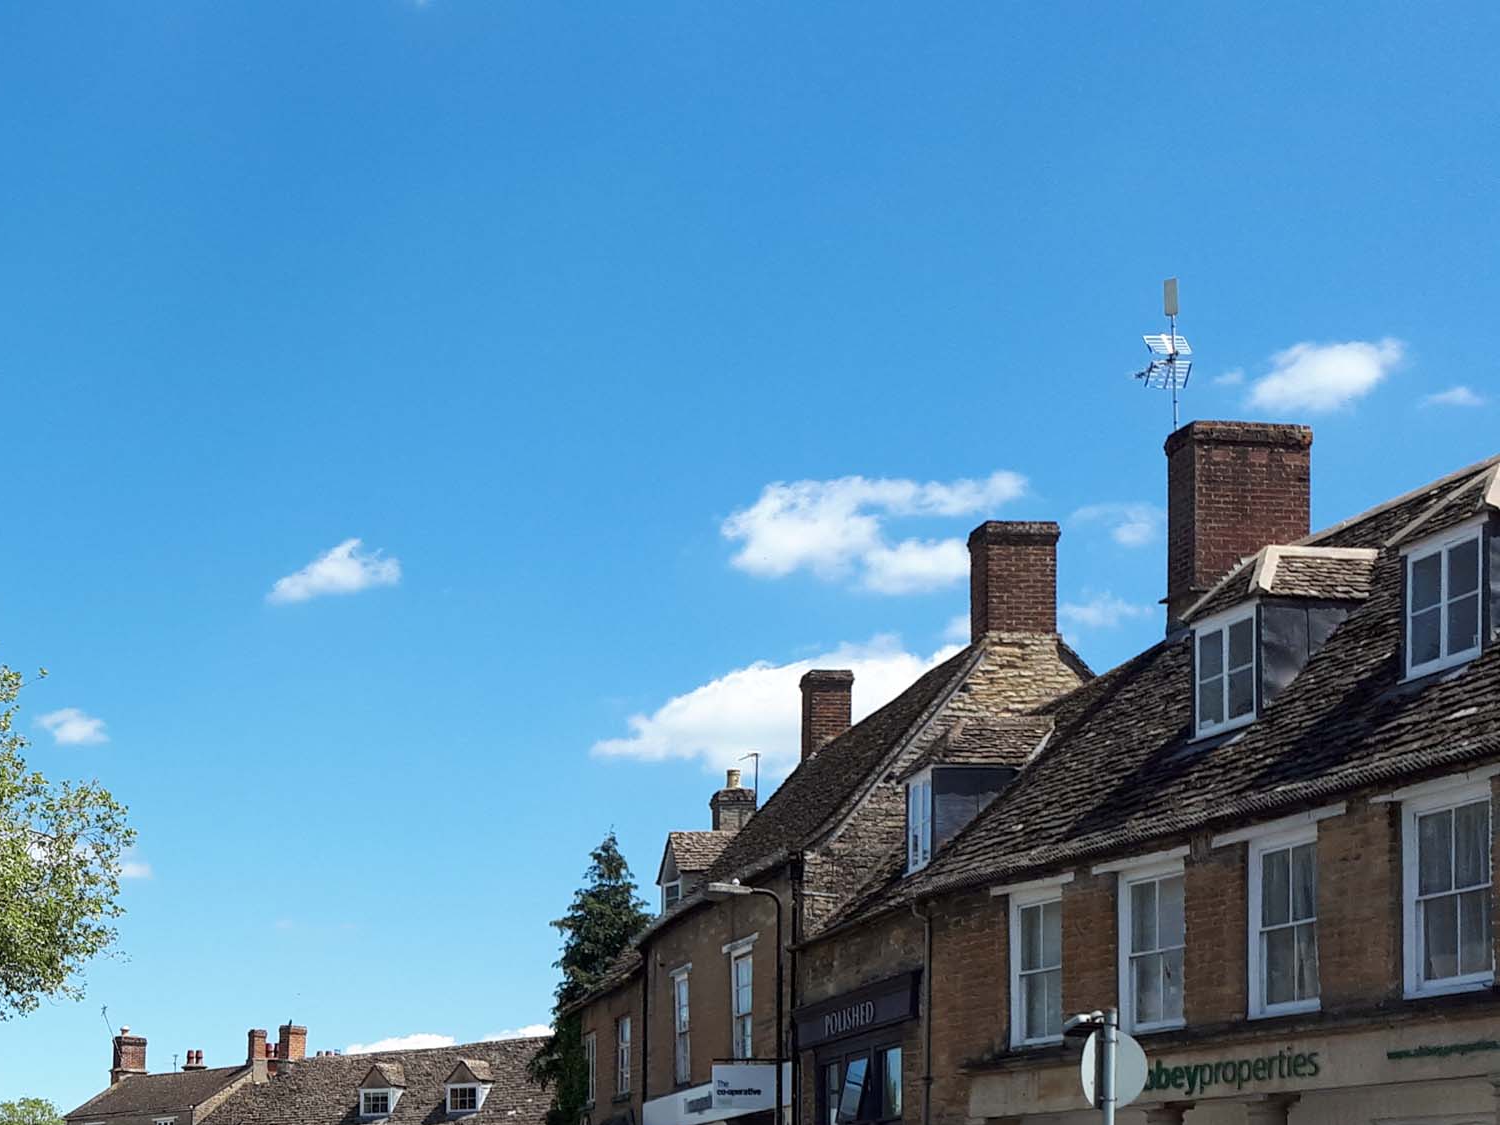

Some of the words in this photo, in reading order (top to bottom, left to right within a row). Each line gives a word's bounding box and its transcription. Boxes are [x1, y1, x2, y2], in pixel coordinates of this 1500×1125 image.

[824, 1001, 874, 1037] POLISHED
[717, 1079, 729, 1088] The
[716, 1087, 762, 1097] co-operative
